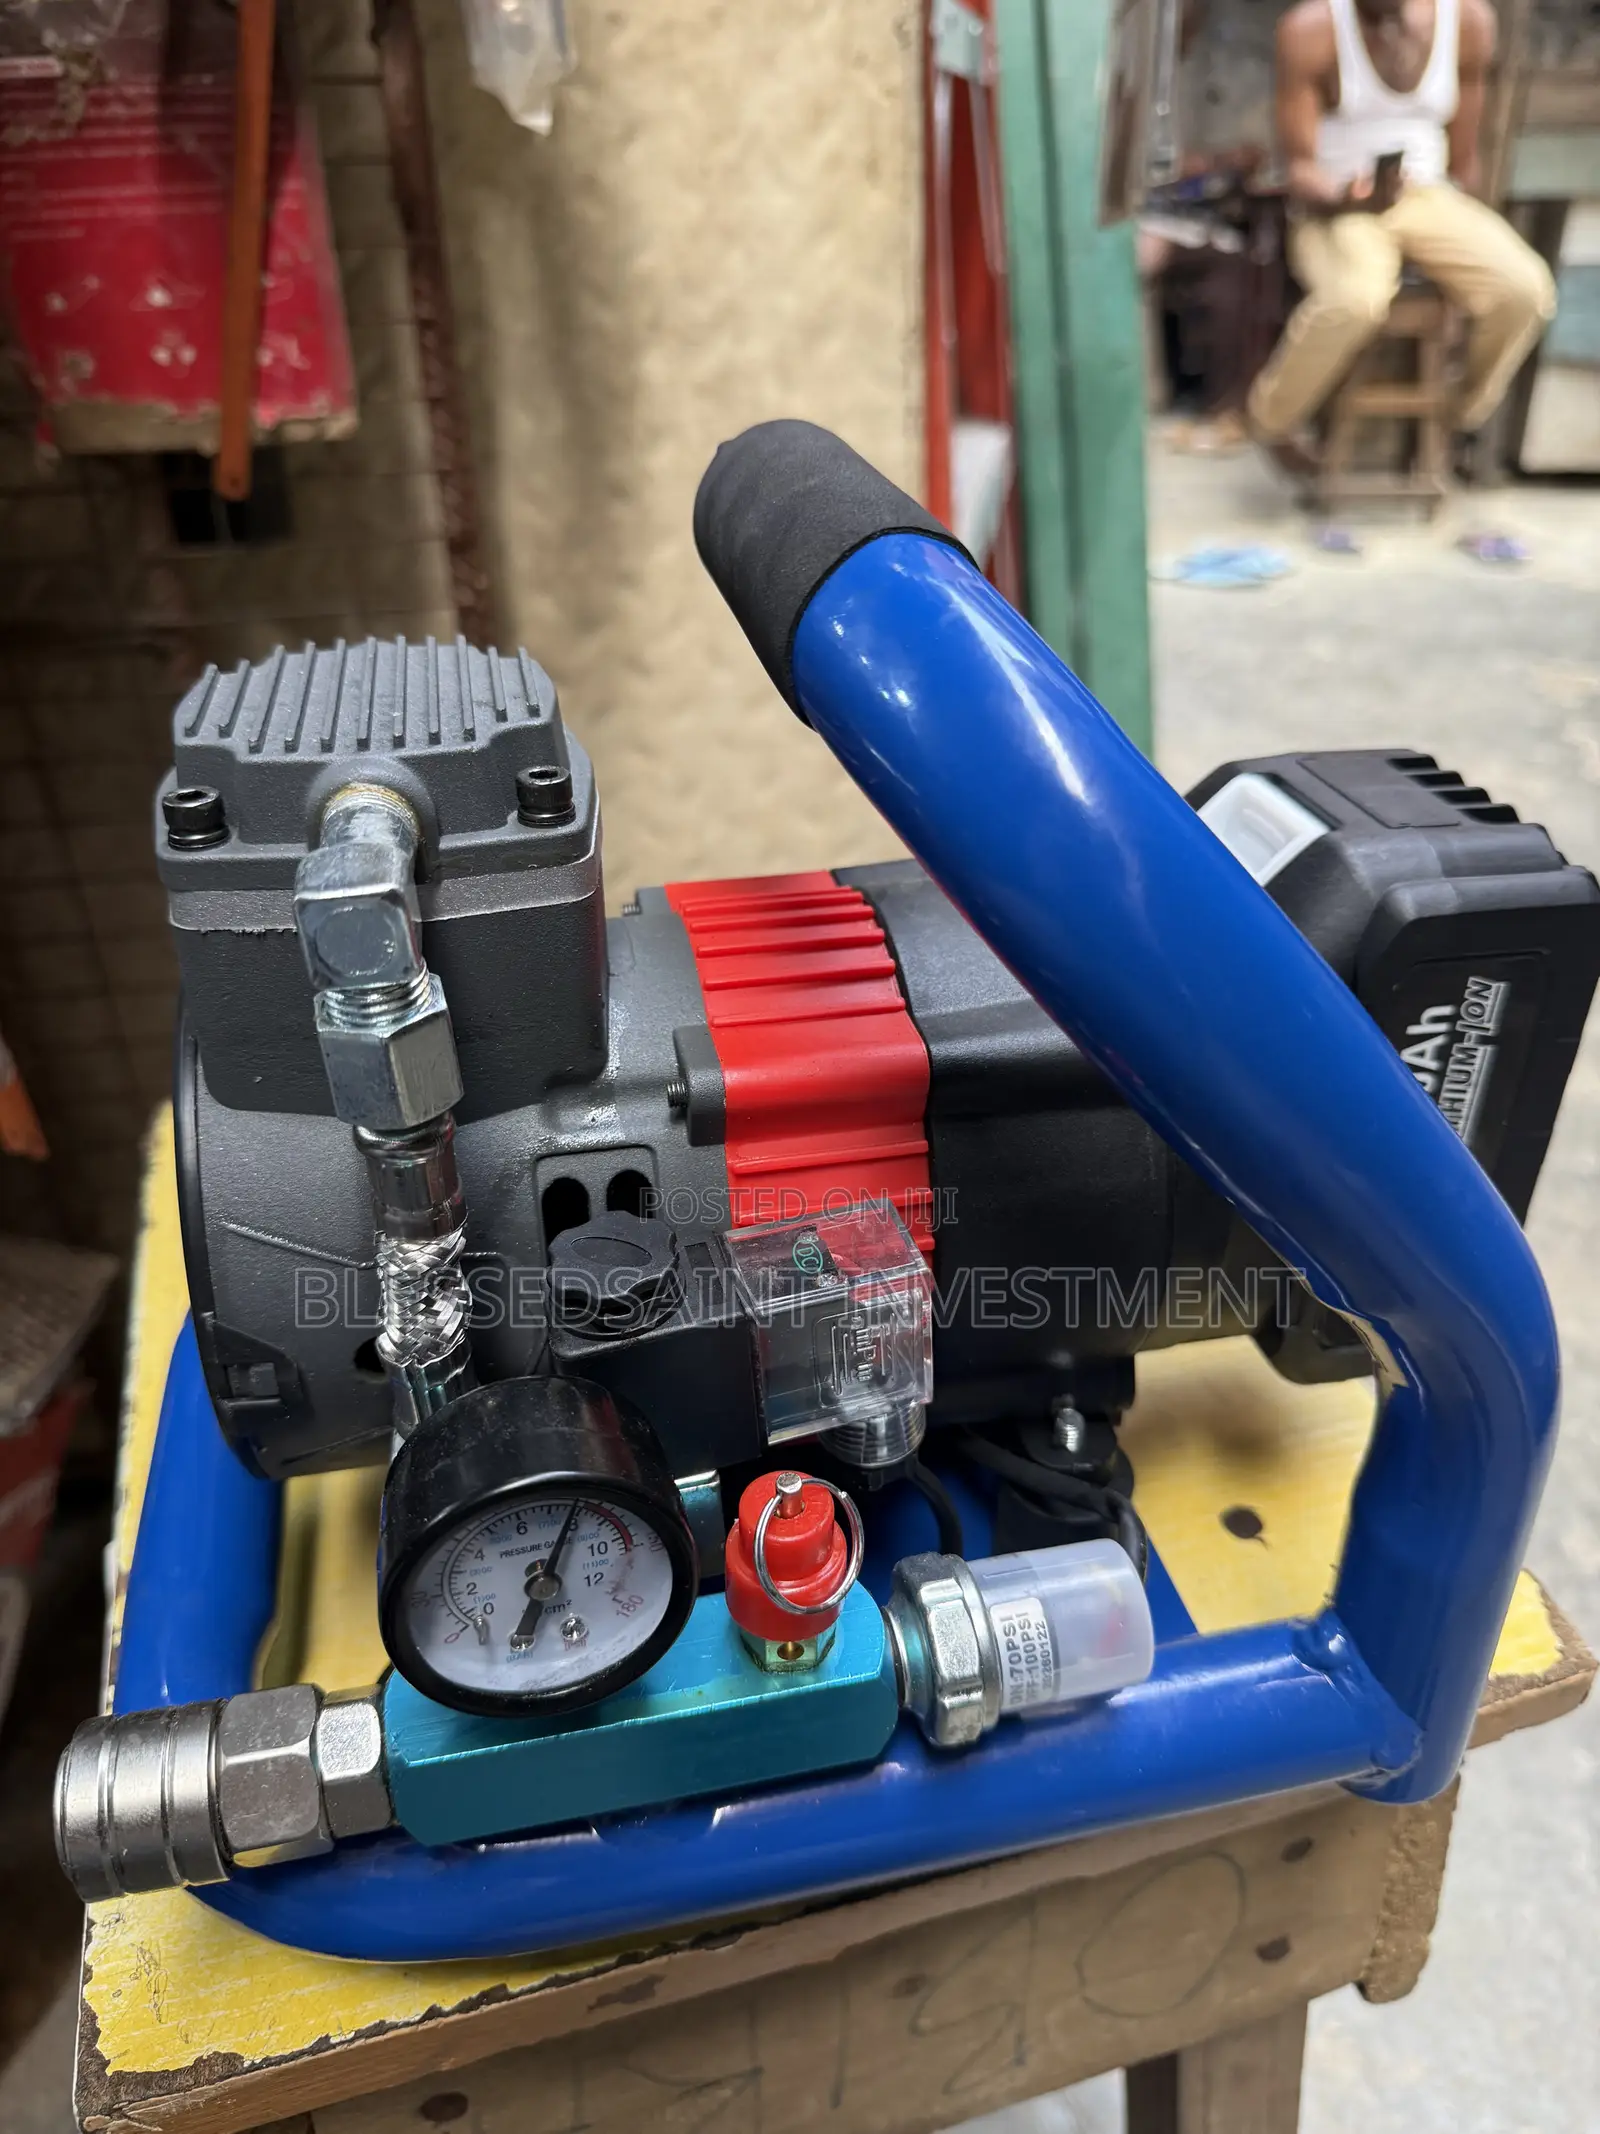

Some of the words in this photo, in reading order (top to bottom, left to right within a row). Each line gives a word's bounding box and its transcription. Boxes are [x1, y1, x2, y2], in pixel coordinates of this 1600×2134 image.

[516, 1521, 528, 1535] 6
[474, 1548, 486, 1561] 4
[500, 1543, 542, 1559] PRESSURE
[587, 1541, 608, 1556] 10
[584, 1572, 604, 1587] 12
[466, 1582, 478, 1595] 2
[483, 1602, 495, 1615] 0
[616, 1594, 644, 1617] 180
